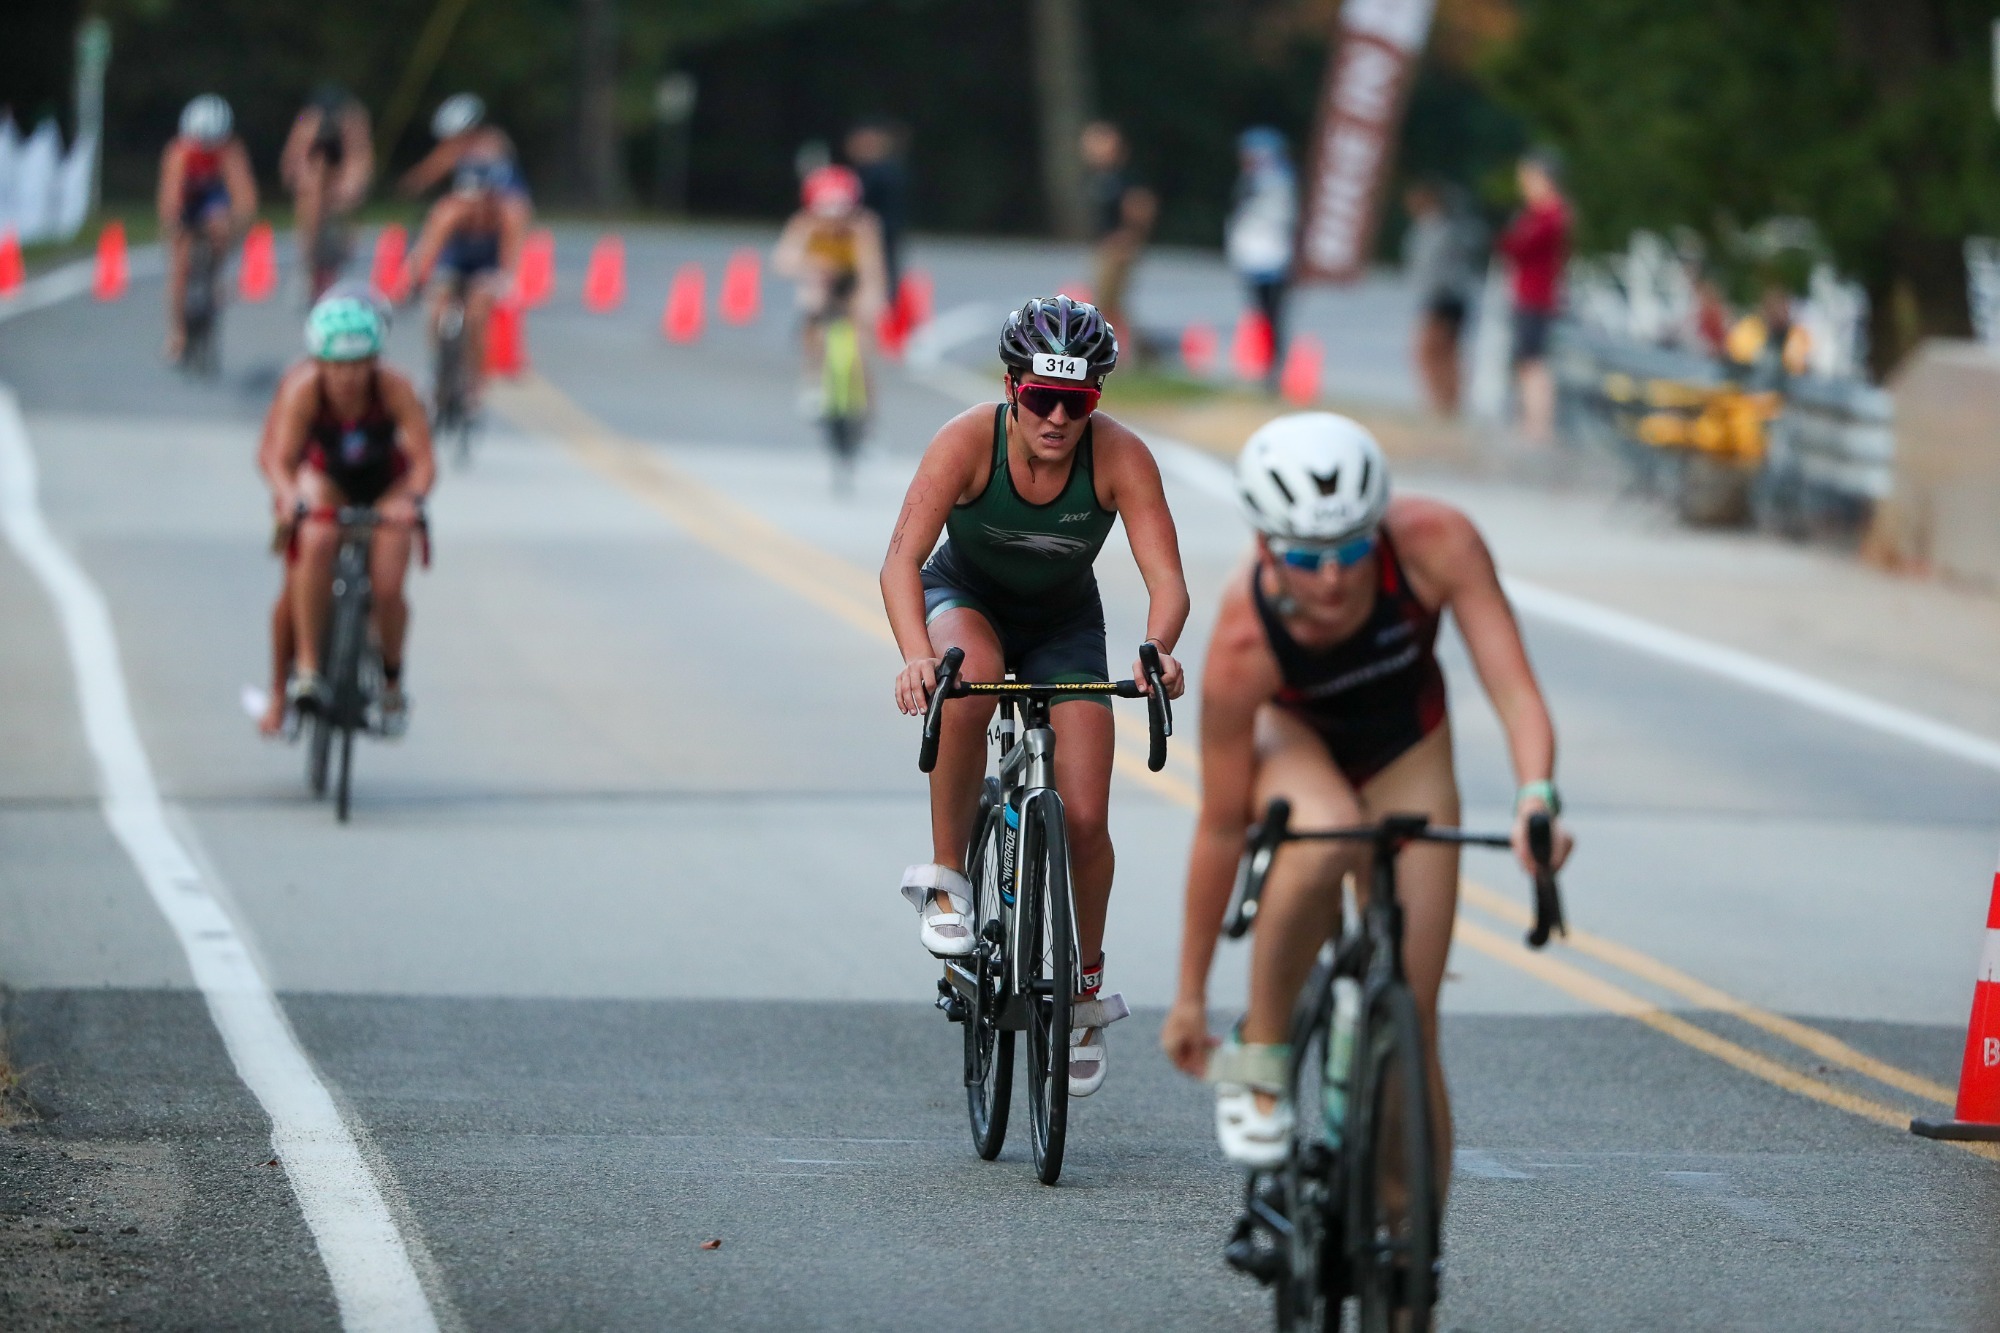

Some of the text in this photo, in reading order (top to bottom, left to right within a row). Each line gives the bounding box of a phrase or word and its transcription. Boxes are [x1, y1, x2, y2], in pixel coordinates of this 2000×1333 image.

[1045, 358, 1076, 375] 314
[986, 724, 1001, 746] 14
[1001, 826, 1017, 895] POWERADE
